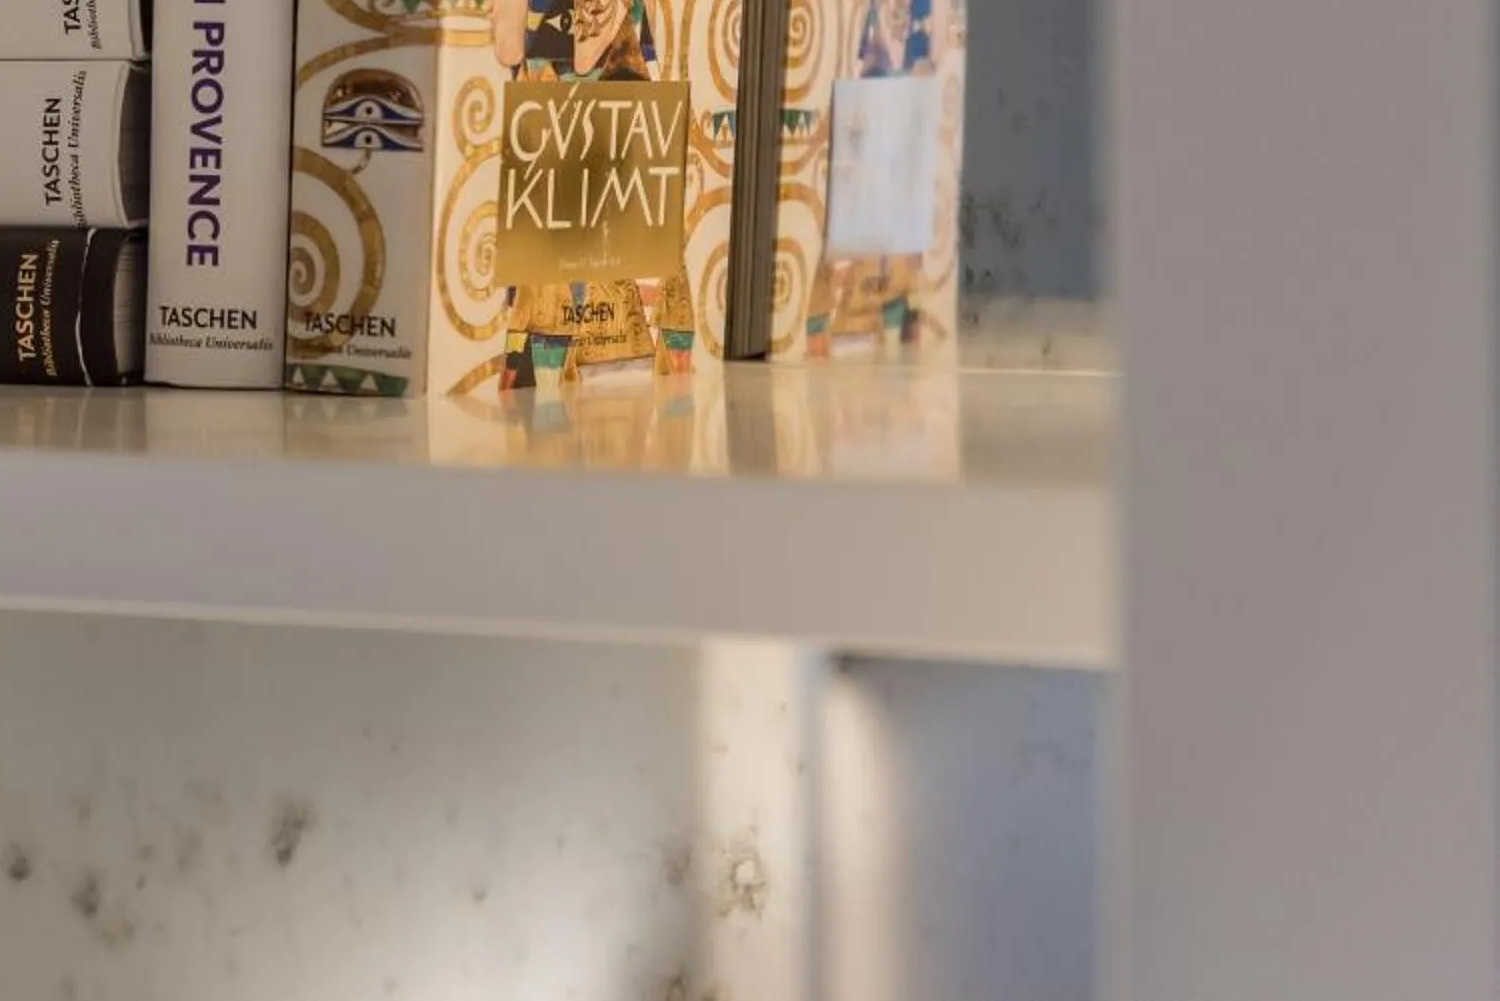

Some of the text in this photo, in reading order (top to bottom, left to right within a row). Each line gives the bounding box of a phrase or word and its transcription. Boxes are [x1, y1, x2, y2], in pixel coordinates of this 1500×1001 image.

[67, 70, 87, 149] Universalis
[41, 97, 63, 206] TASCHEN
[185, 19, 227, 268] PROVENCE
[505, 165, 680, 230] KLIMT
[15, 253, 39, 363] TASCHEN
[160, 305, 258, 331] TASCHEN
[304, 310, 397, 338] TASCHEN
[562, 301, 615, 326] TASCHEN
[204, 333, 274, 352] Universalis
